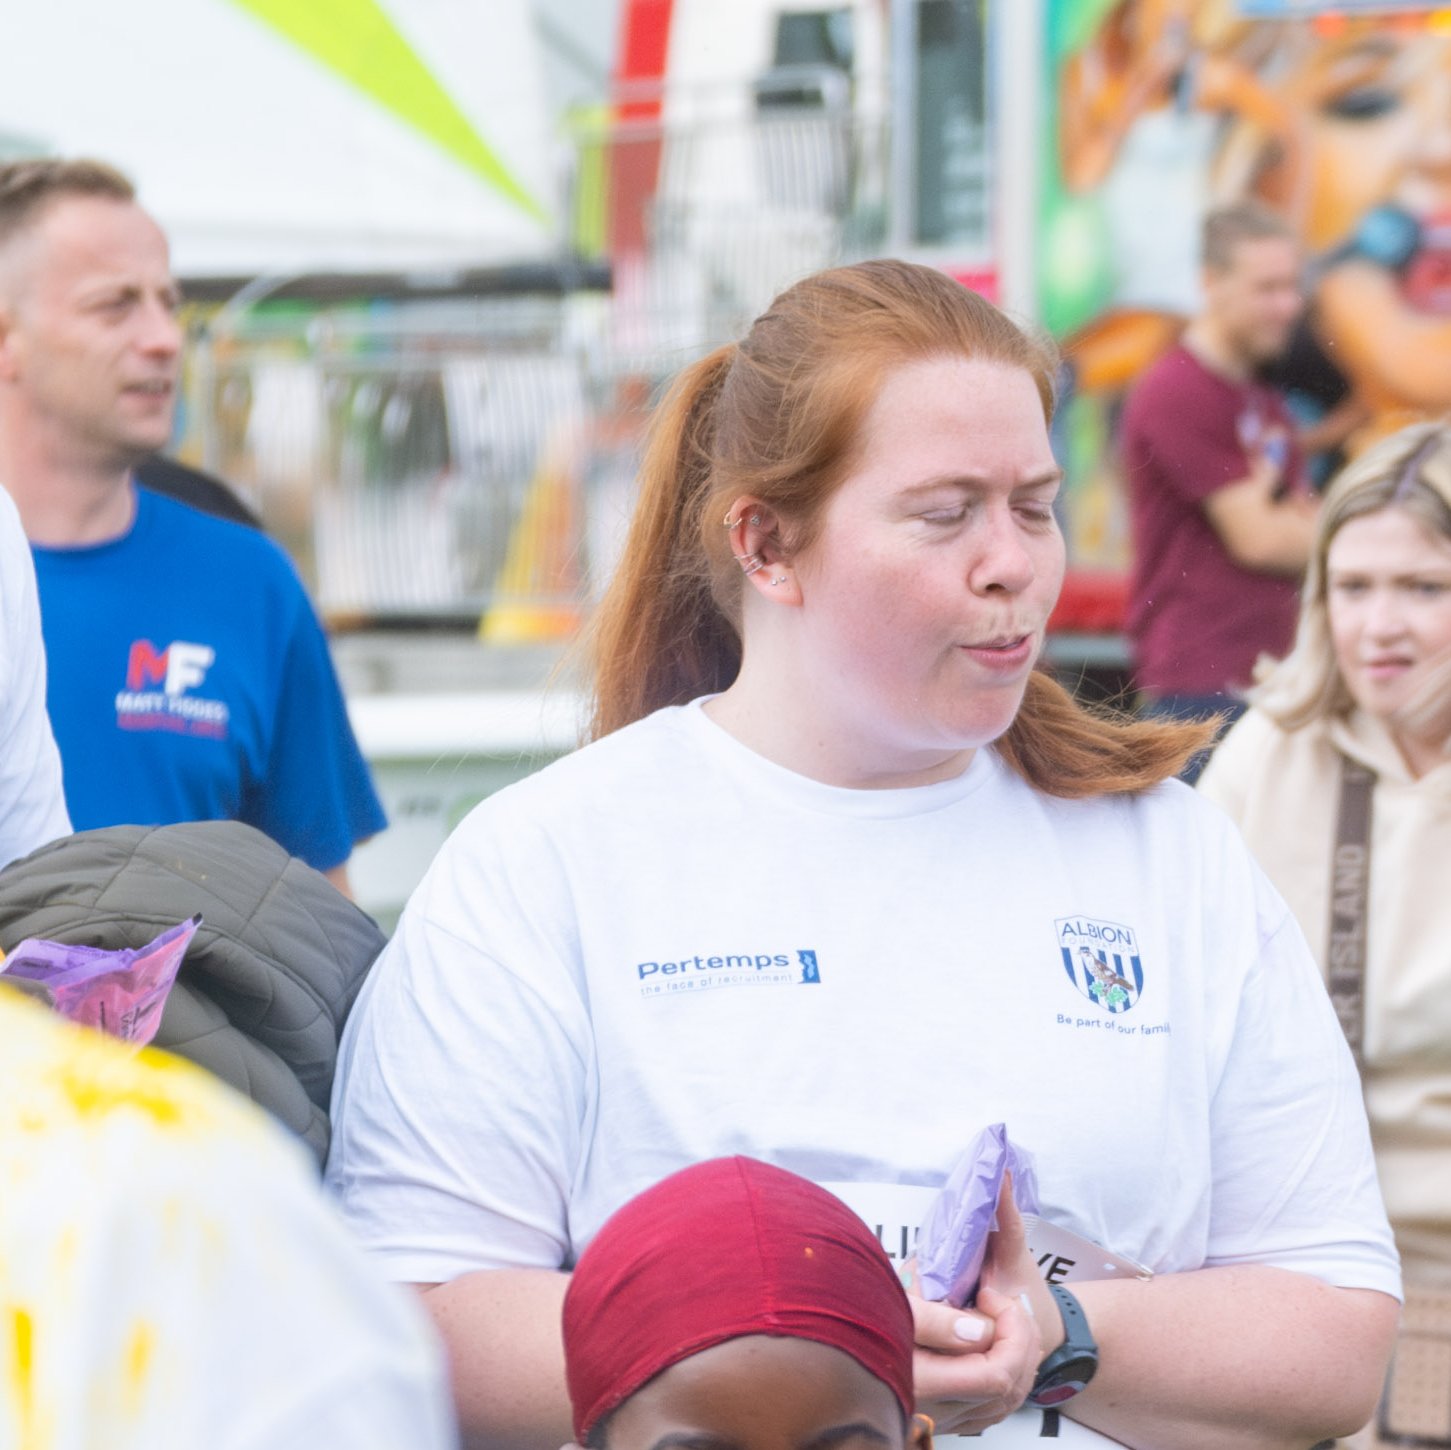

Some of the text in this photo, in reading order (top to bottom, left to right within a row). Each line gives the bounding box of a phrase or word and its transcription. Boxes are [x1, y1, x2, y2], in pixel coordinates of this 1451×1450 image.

[1331, 844, 1365, 979] ISLAND
[1061, 921, 1132, 945] ALBION
[637, 954, 790, 980] Pertemps
[641, 973, 793, 997] the face of recruitment
[1056, 1013, 1072, 1024] Be
[1076, 1017, 1101, 1029] part
[1105, 1020, 1116, 1030] of
[1117, 1025, 1137, 1035] our
